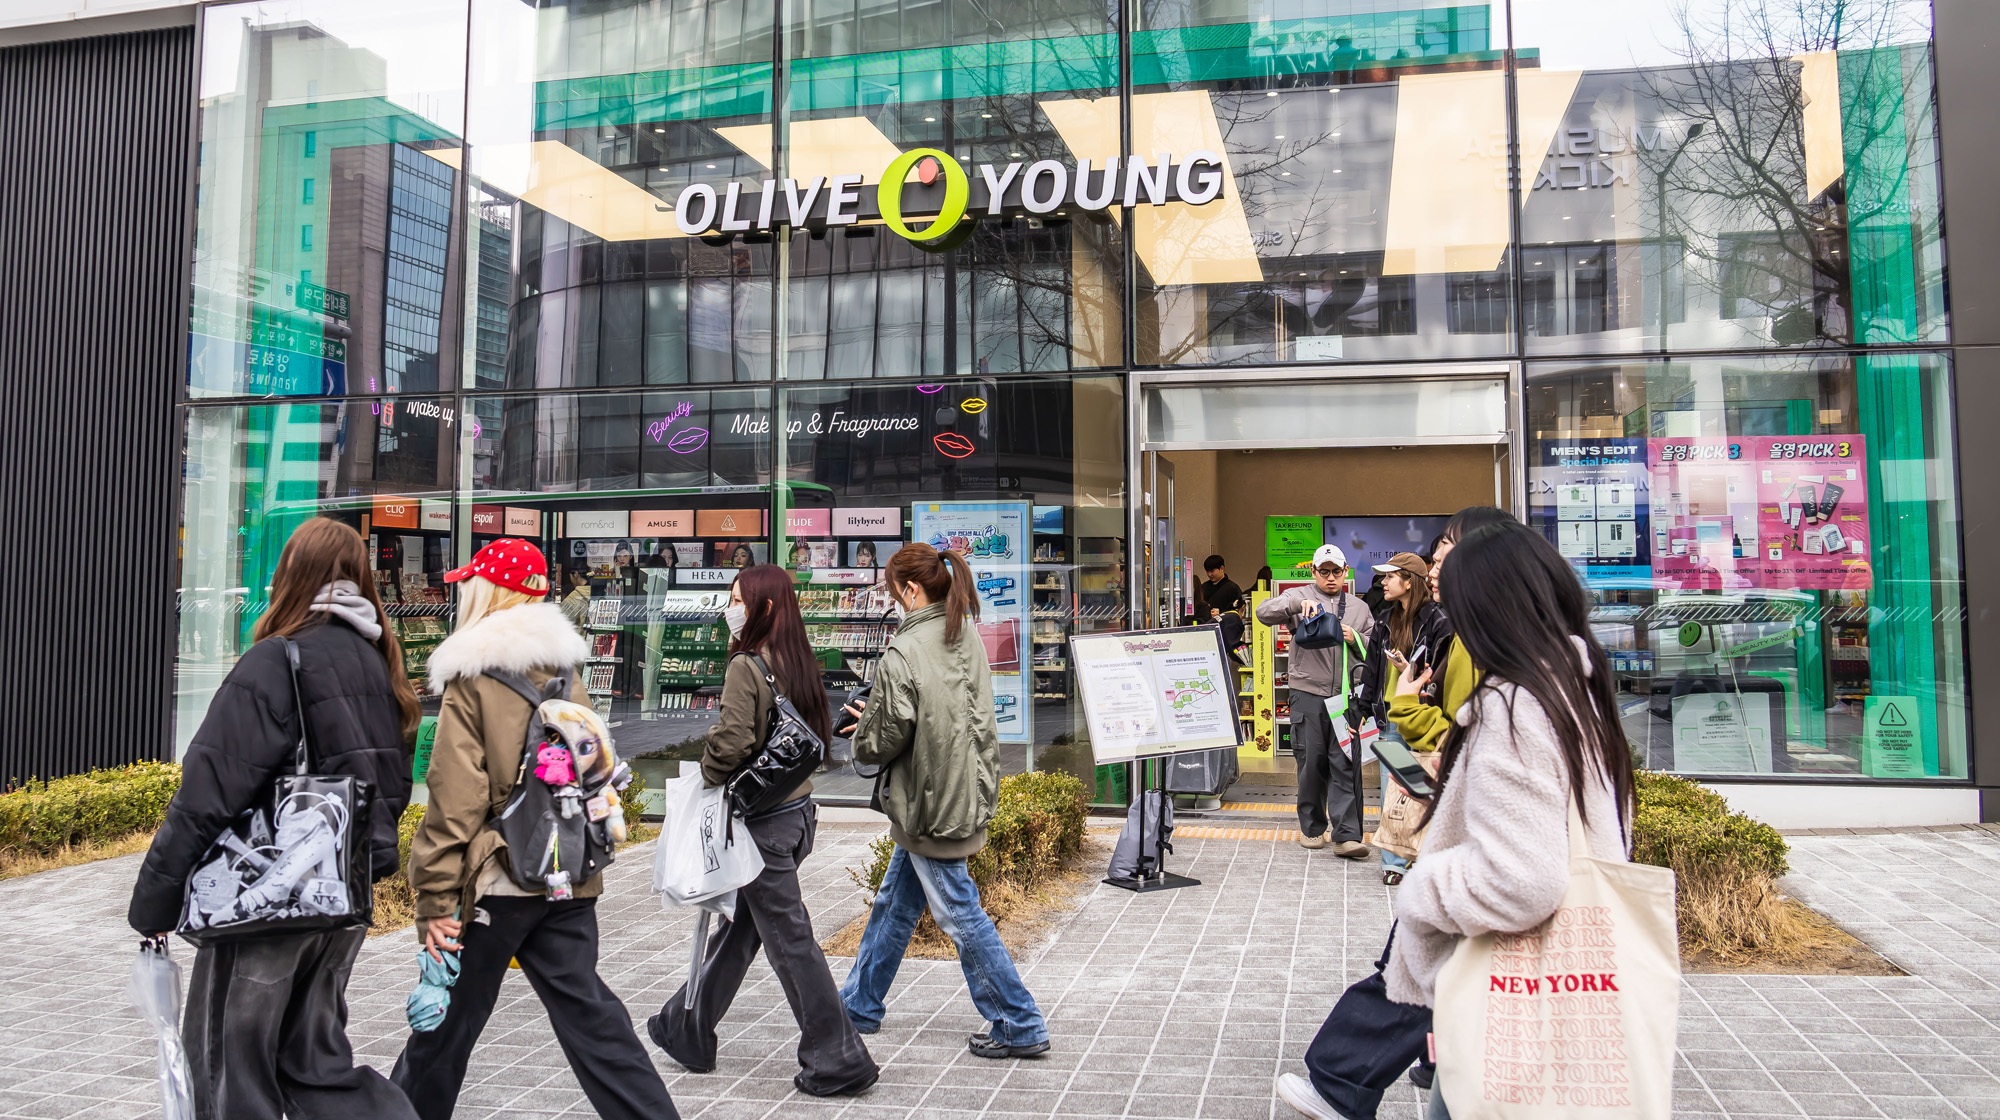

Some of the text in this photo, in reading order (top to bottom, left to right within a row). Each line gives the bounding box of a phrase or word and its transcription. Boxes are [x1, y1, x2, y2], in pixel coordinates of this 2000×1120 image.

[675, 150, 1224, 235] OLIVE YOUNG
[407, 401, 441, 418] Make
[646, 401, 694, 443] Beauty
[730, 413, 771, 437] Mak
[807, 413, 823, 433] &
[828, 411, 919, 438] Fragrance
[1551, 446, 1638, 456] MEN'S EDIT
[1661, 444, 1741, 461] 올영 PICK 3
[1769, 442, 1851, 459] 올영 PICK 3
[1560, 457, 1630, 469] Special Price
[385, 504, 405, 514] CLIO
[429, 512, 451, 520] wakemak
[473, 512, 495, 526] espoir
[511, 518, 527, 526] BANILA
[581, 519, 615, 529] rom&nd
[647, 520, 678, 528] AMUSE
[786, 517, 813, 527] TUDE
[848, 516, 886, 527] lilybyred
[677, 545, 704, 553] AMUSE
[1369, 551, 1382, 559] THE
[691, 571, 724, 580] HERA
[828, 571, 855, 580] colorgram
[1290, 570, 1313, 578] K-BEAU
[1773, 599, 1802, 612] hello
[1730, 632, 1790, 656] K-BEAUTY NOW
[1554, 906, 1615, 927] ORK
[1545, 928, 1616, 950] YORK
[1490, 950, 1618, 974] NEW YORK
[1489, 973, 1619, 996] NEW YORK
[1487, 995, 1622, 1017] NEW YORK
[1486, 1016, 1625, 1038] NEW YORK
[1485, 1036, 1628, 1060] NEW YORK
[1484, 1058, 1629, 1083] NEW YORK
[1483, 1081, 1631, 1107] NEW YORK
